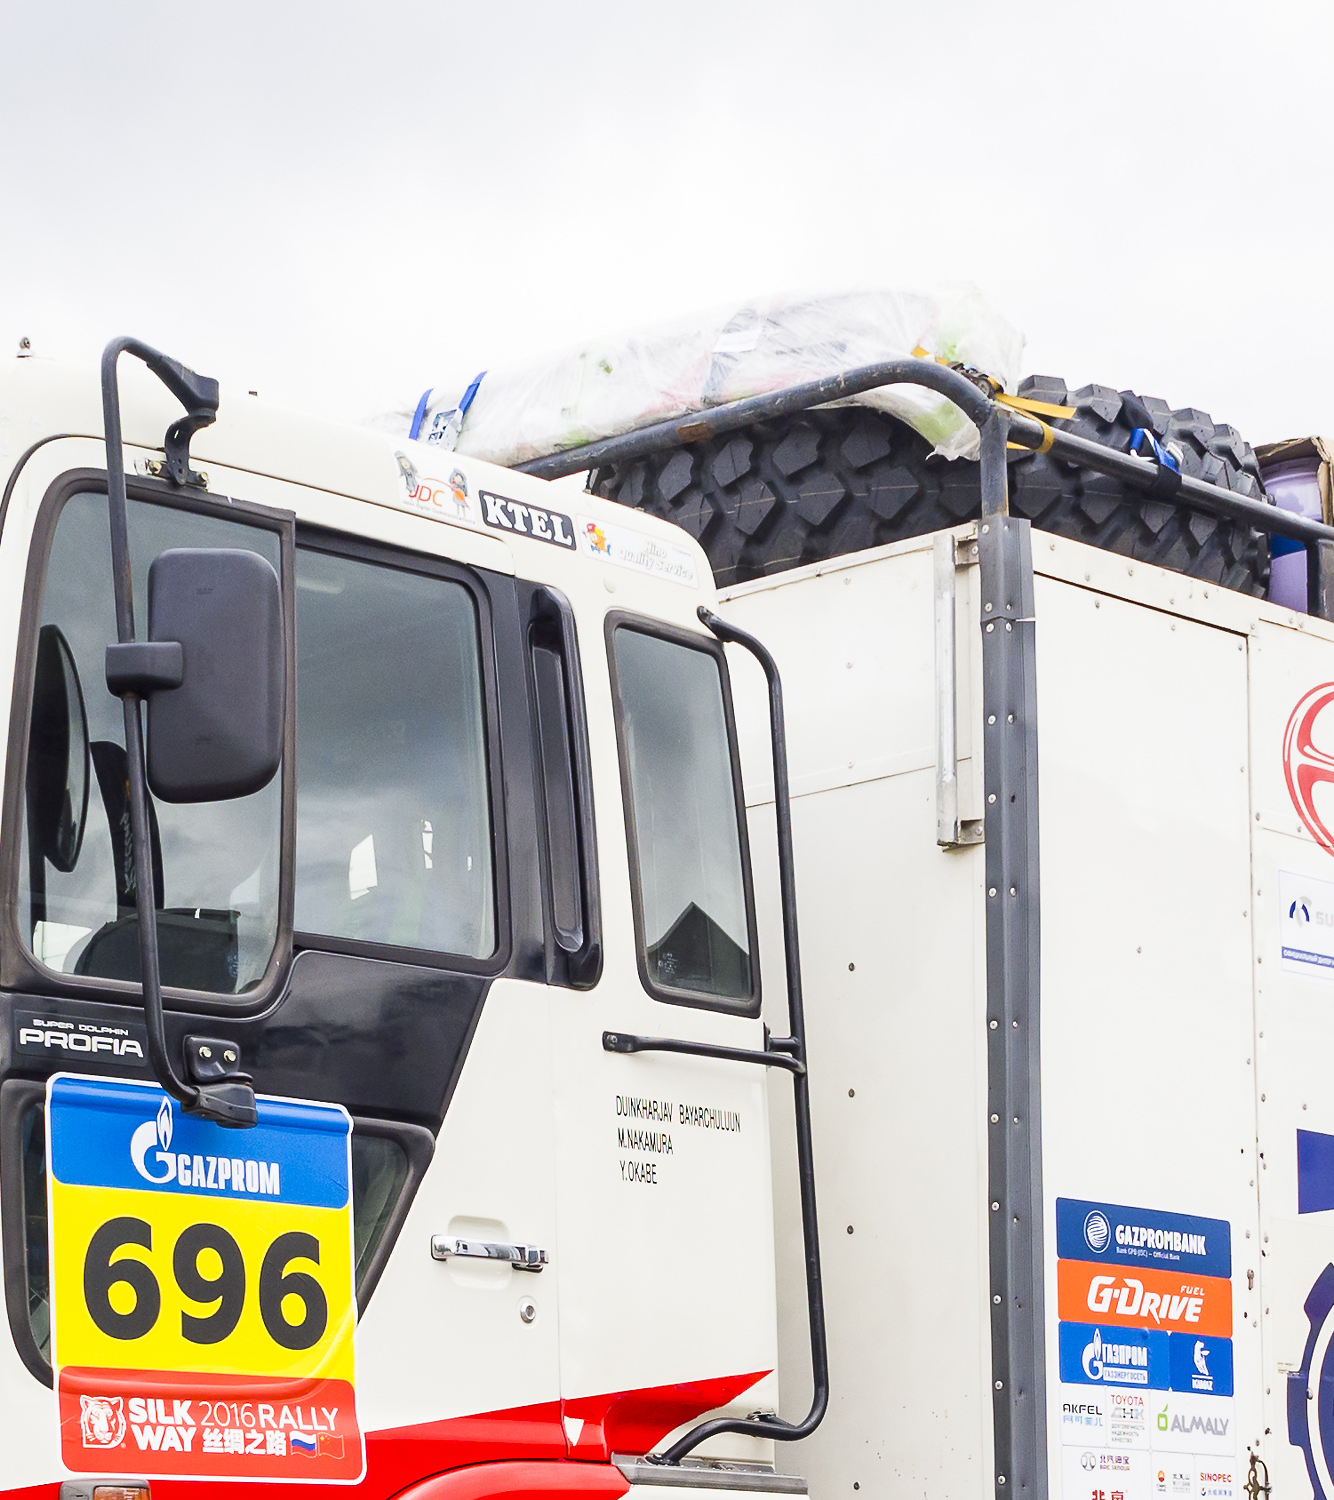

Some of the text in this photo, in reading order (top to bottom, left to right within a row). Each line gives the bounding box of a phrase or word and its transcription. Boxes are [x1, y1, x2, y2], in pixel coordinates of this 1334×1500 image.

[409, 485, 445, 507] JDC
[482, 495, 573, 547] KTEL
[32, 1019, 129, 1037] SUPER DOLPHIN
[19, 1028, 144, 1058] PROFIA
[618, 1127, 674, 1155] M.NAKAMURA
[177, 1155, 280, 1197] GAZPROM
[619, 1159, 658, 1185] Y.OKABE
[1115, 1224, 1207, 1256] GAZPROMBANK
[83, 1216, 328, 1351] 696
[1180, 1285, 1205, 1297] FUEL
[1102, 1343, 1148, 1367] ГАЗПРОМ
[1062, 1403, 1102, 1416] AKFEL
[1111, 1394, 1144, 1406] TOYOTA
[129, 1399, 339, 1432] SILK 2016 RALLY
[1170, 1414, 1229, 1436] ALMALY
[132, 1425, 197, 1452] WAY
[1200, 1472, 1232, 1483] SINOPEC
